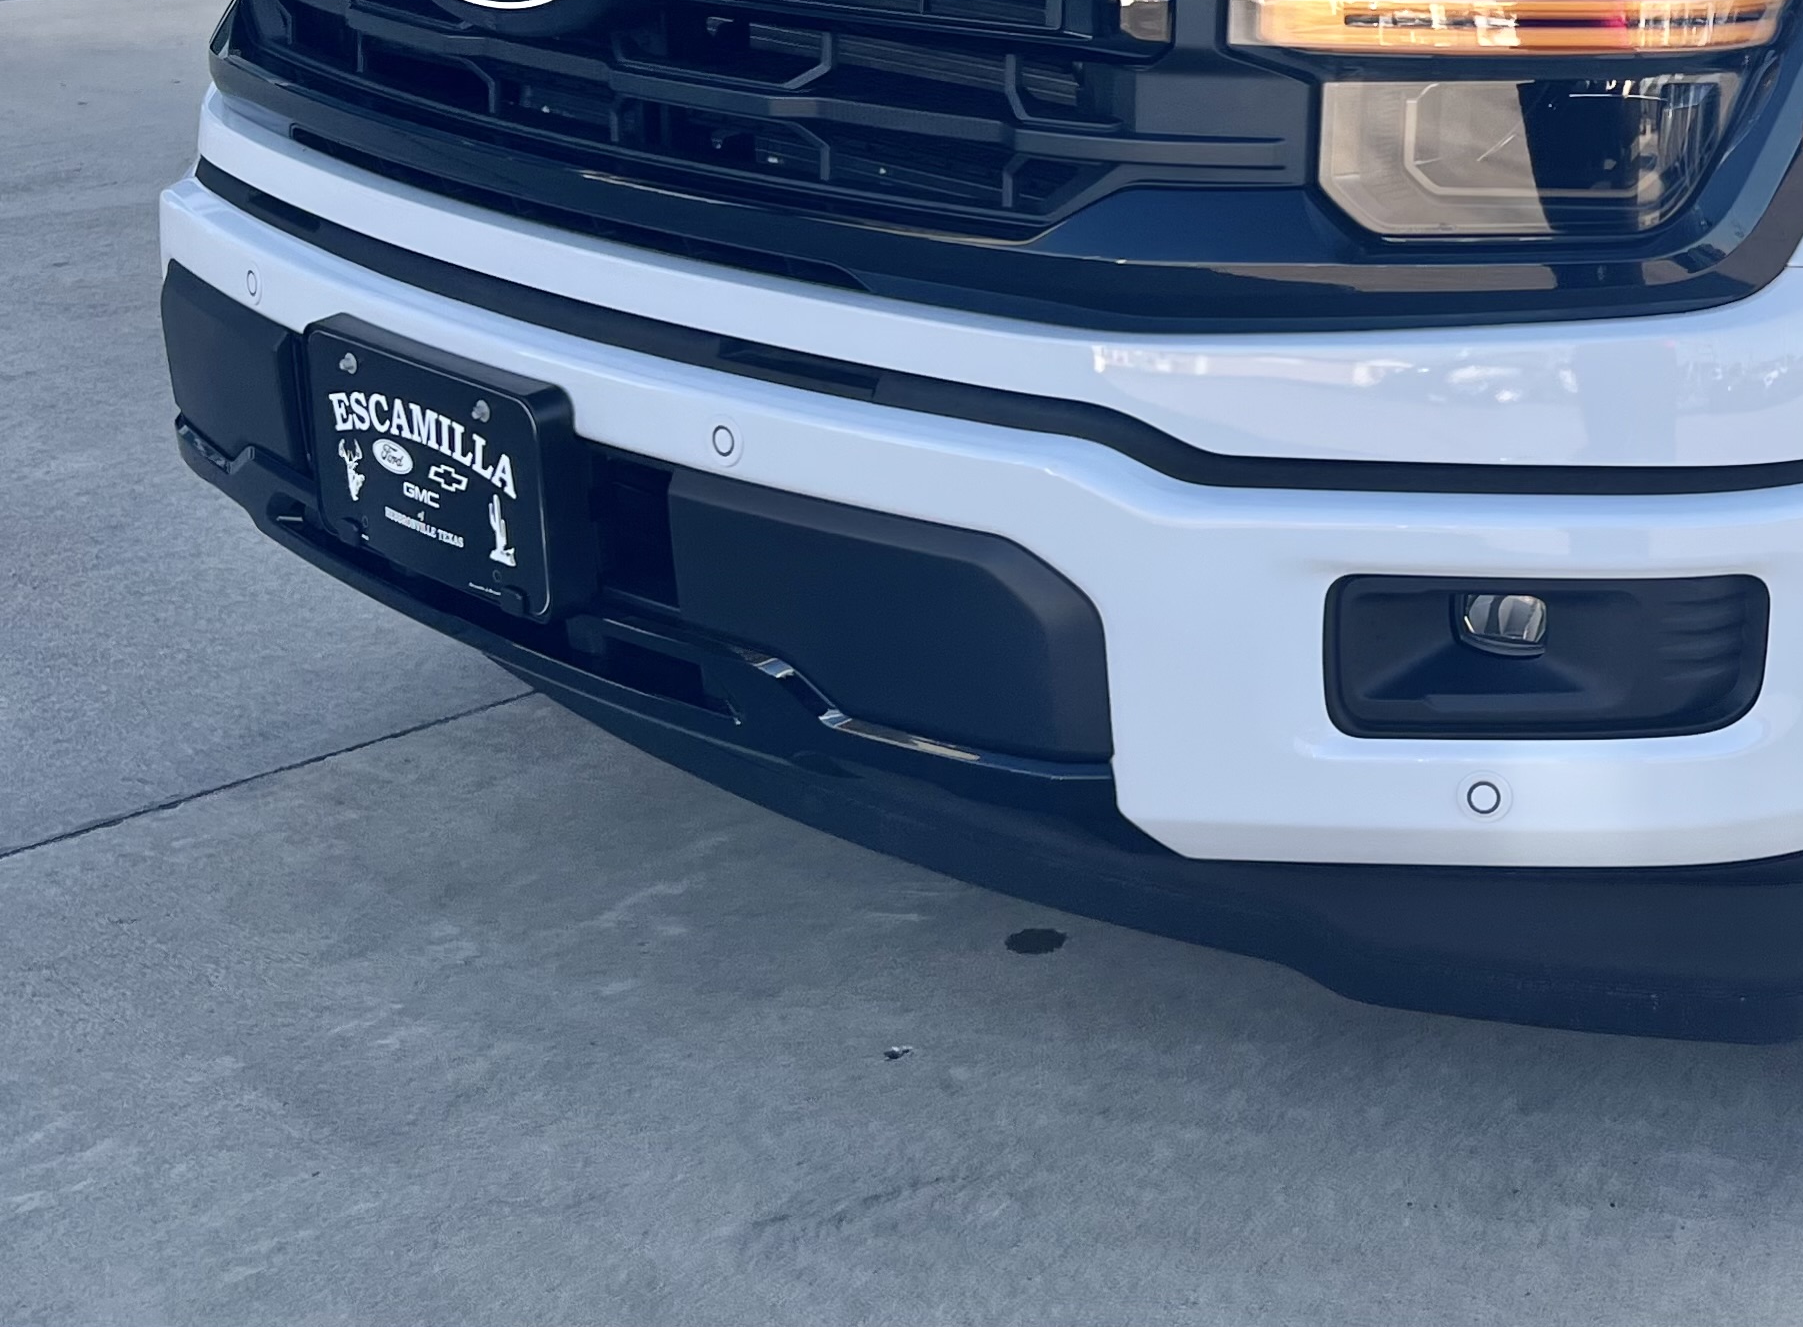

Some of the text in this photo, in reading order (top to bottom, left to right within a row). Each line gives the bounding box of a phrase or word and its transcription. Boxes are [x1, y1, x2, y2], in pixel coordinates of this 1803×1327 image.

[329, 391, 517, 500] ESCAMILLA
[403, 481, 440, 508] GMC
[437, 528, 464, 548] TEXAS
